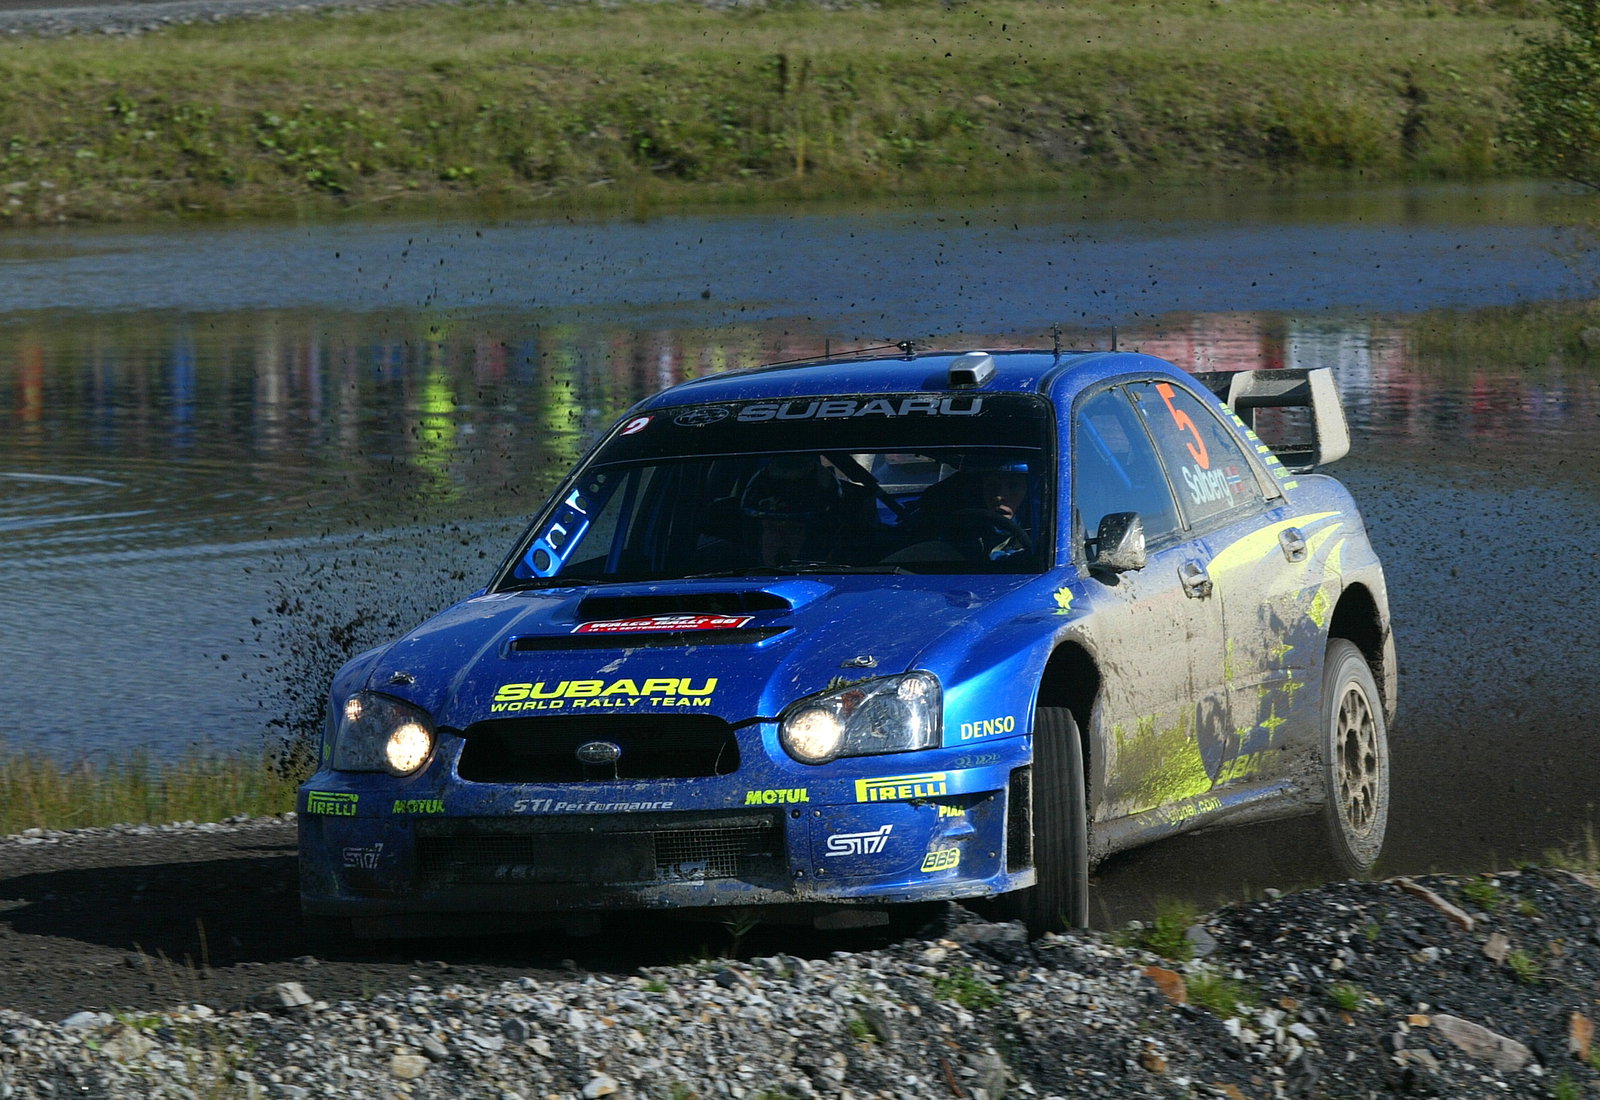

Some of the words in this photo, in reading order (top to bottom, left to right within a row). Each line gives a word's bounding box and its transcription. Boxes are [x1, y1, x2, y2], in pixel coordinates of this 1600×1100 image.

[737, 396, 983, 422] SUBARU
[1155, 383, 1210, 470] 5
[1181, 465, 1234, 506] Solberg
[654, 618, 709, 626] RALLY
[495, 677, 718, 701] SUBARU
[490, 700, 564, 712] WORLD
[573, 697, 640, 709] RALLY
[650, 695, 713, 707] TEAM
[961, 716, 1015, 740] DENSO
[744, 788, 810, 805] MOTUL
[855, 773, 947, 802] PIRELLI
[307, 791, 359, 816] PIRELLI
[392, 799, 446, 814] MOTUL
[555, 799, 674, 812] Performance
[922, 848, 959, 871] BBS
